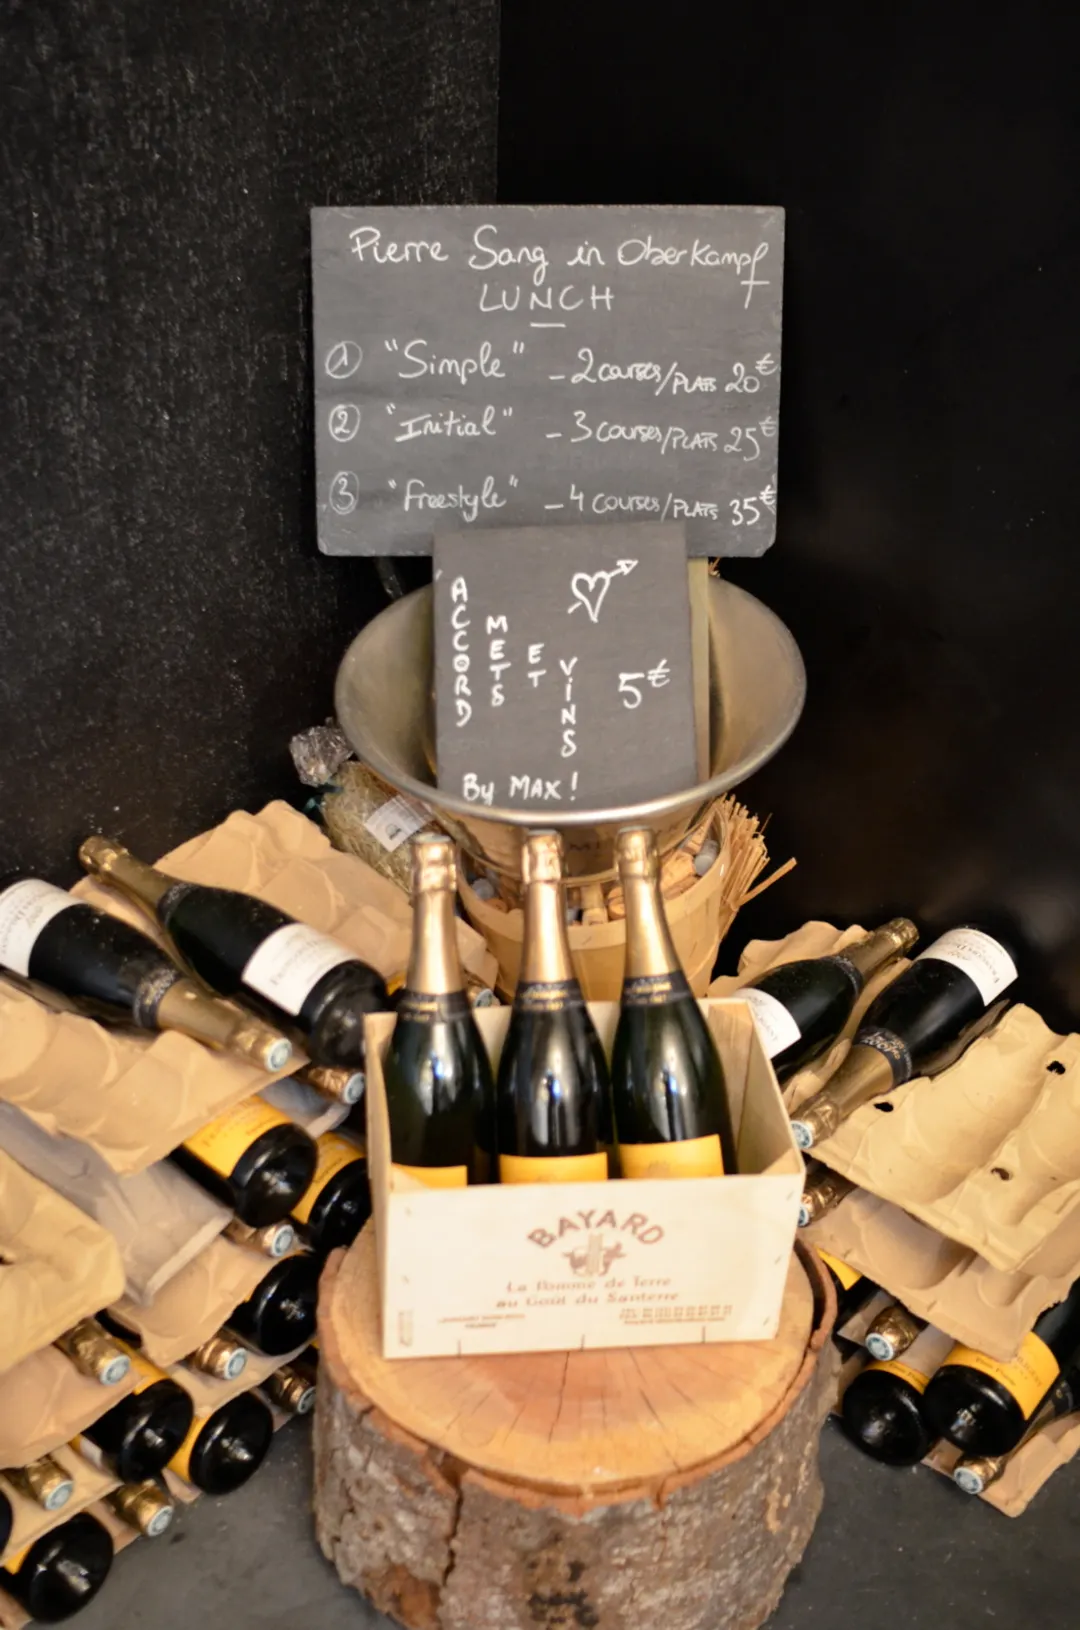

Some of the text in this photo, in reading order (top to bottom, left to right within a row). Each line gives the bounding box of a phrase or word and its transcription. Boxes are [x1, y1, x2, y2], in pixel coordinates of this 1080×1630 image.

[349, 226, 449, 264] Pierre
[468, 224, 549, 285] Sang
[567, 240, 606, 266] in
[479, 284, 615, 312] LUNCH
[451, 576, 472, 728] ACCORD
[486, 615, 511, 708] METS
[527, 643, 547, 688] ET
[617, 658, 671, 709] 5€
[462, 772, 495, 807] By
[527, 1209, 665, 1248] BAYARD
